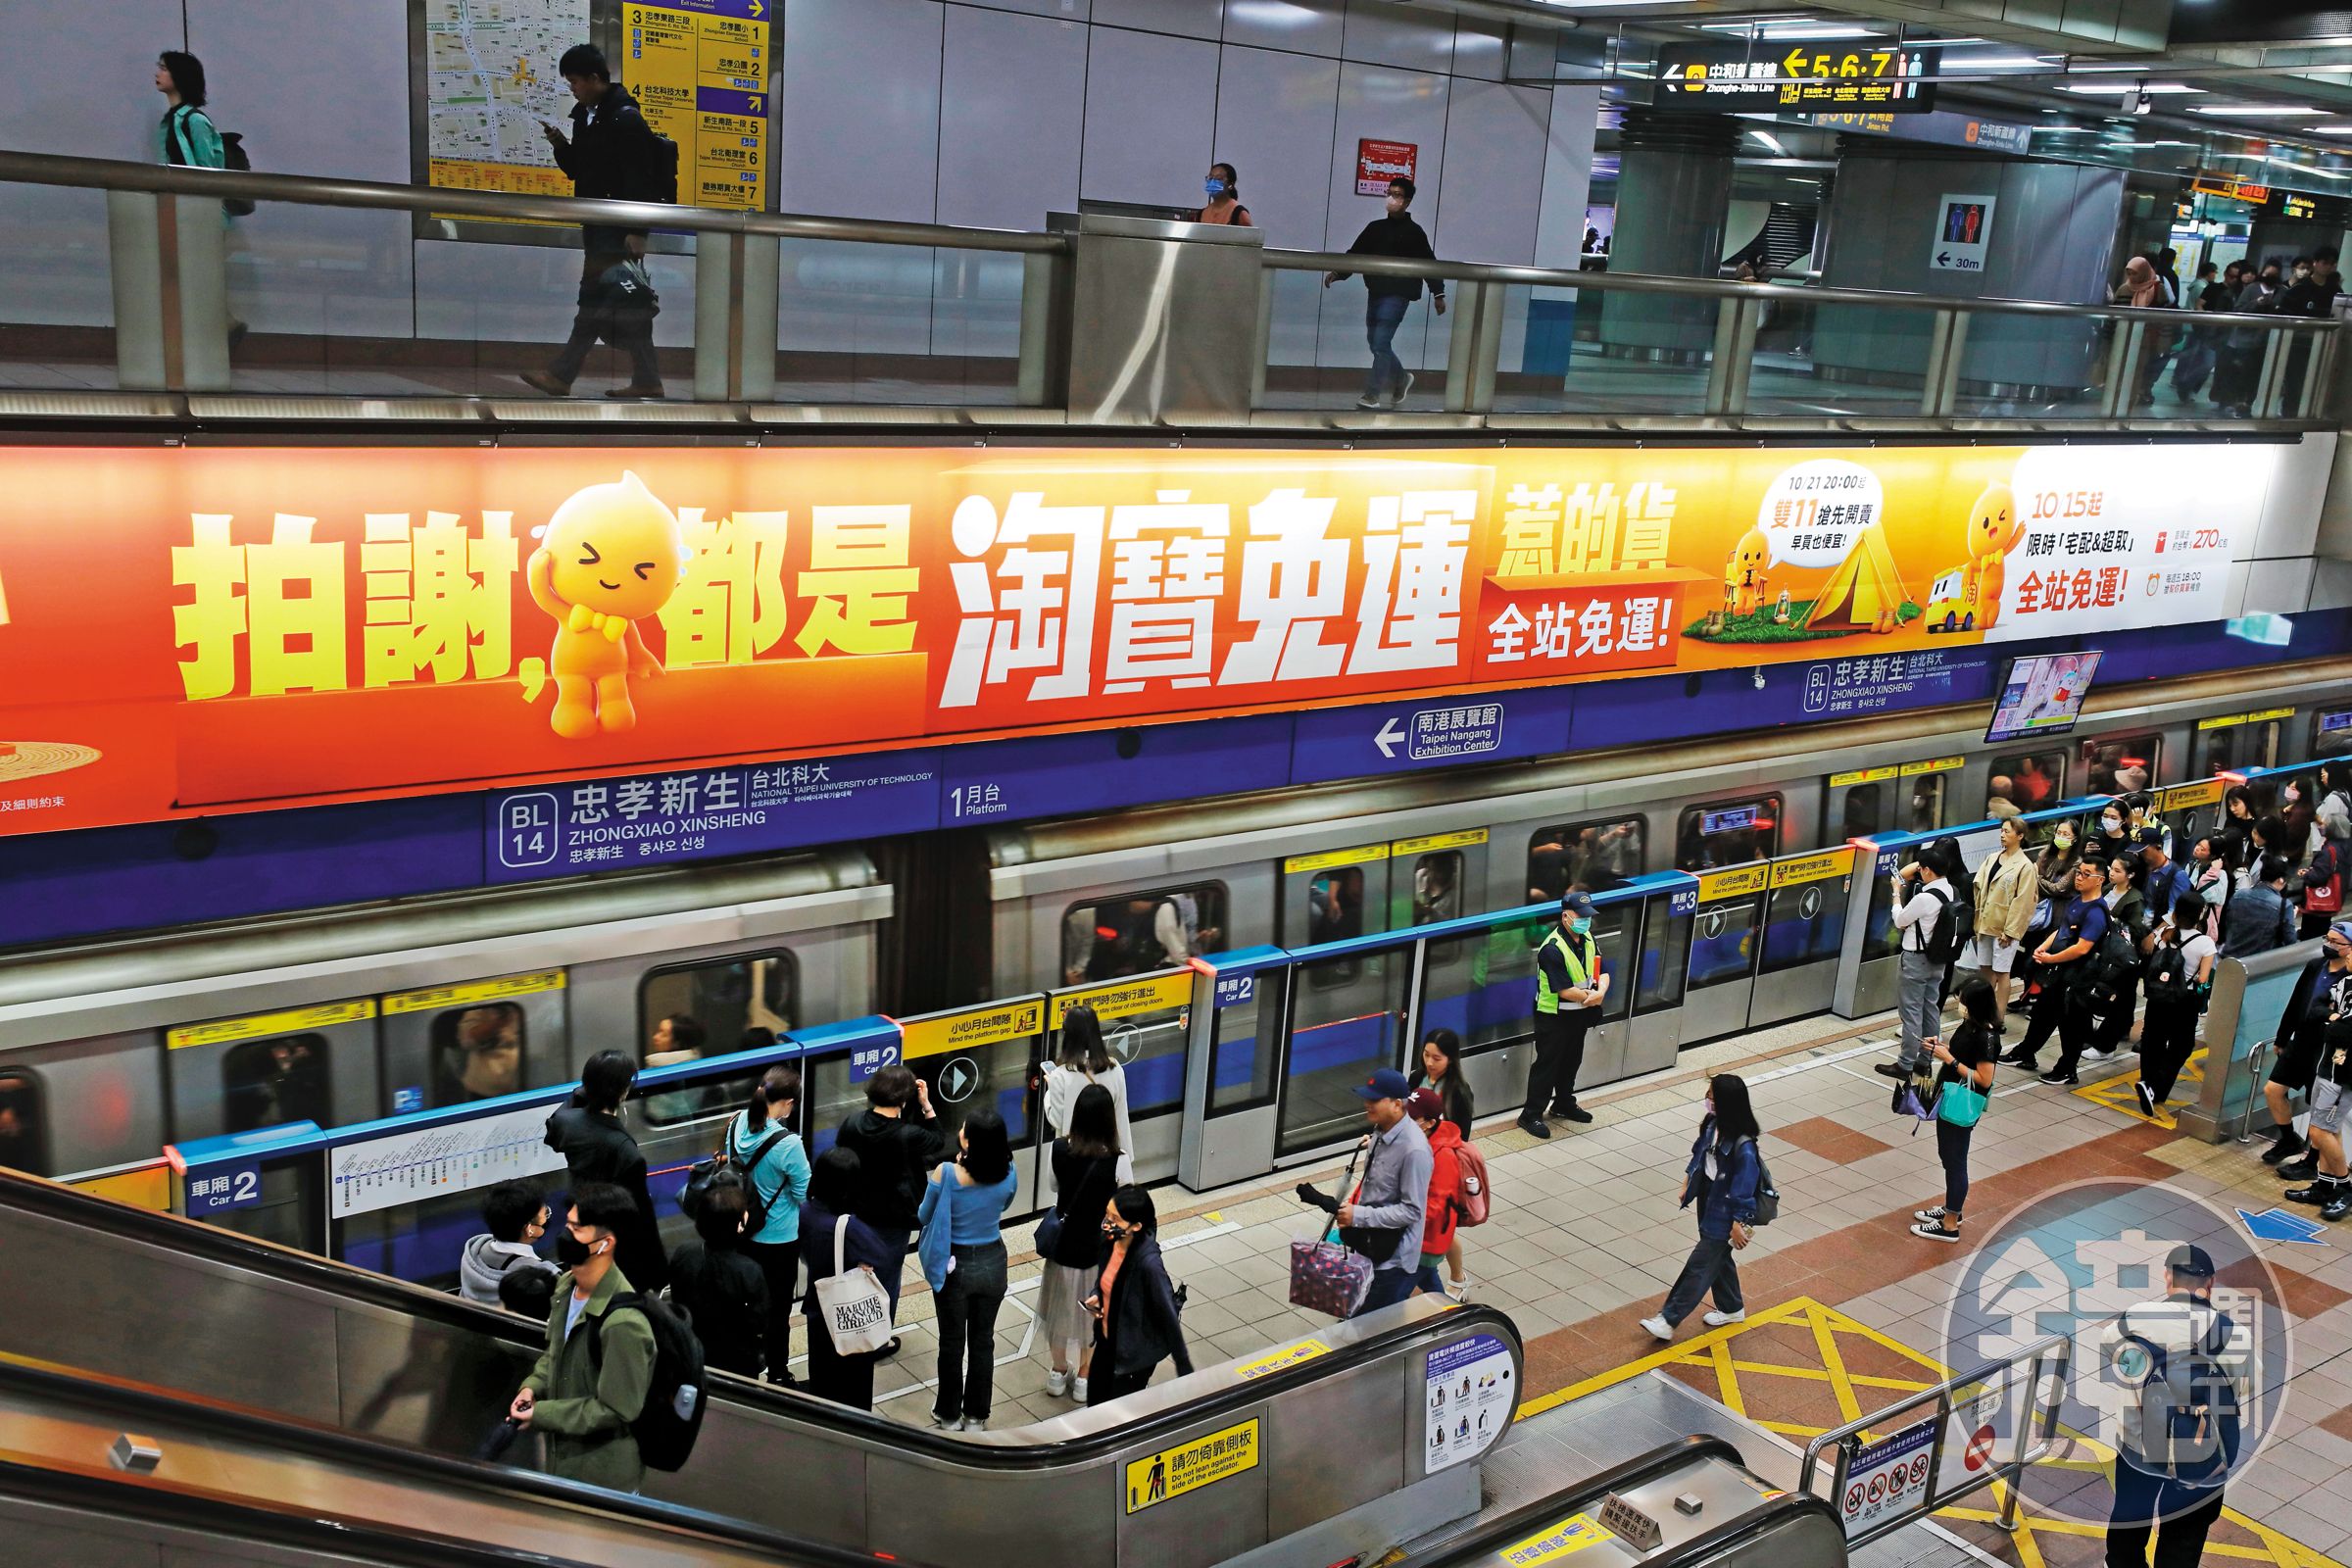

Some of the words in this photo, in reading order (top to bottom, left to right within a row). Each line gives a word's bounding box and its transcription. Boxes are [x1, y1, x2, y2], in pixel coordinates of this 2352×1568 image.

[633, 10, 642, 24] 3
[646, 12, 691, 25] 忠孝東路三段
[719, 22, 749, 32] 忠孝國小
[753, 27, 759, 39] 1
[718, 59, 748, 70] 忠孝公園
[751, 63, 760, 75] 2
[632, 84, 641, 97] 4
[645, 84, 689, 96] 台北科技大學
[704, 116, 747, 127] 新生南路一段
[750, 122, 758, 134] 5
[750, 152, 758, 165] 6
[749, 186, 757, 199] 7
[1956, 258, 1980, 270] 30m
[1771, 498, 1873, 529] 雙11搶先開賣
[657, 504, 920, 670] 都是
[938, 488, 1479, 709] 淘寶免運
[1496, 481, 1677, 576] 惹的貨
[1909, 652, 1943, 668] 台北科大
[1810, 671, 1826, 688] BL
[1834, 655, 1906, 686] 忠孝新生
[1809, 690, 1823, 705] 14
[1832, 686, 1875, 700] ZHONGXIAO
[1876, 681, 1913, 695] XINSHENG
[1417, 707, 1497, 733] 南港展覽館
[1421, 731, 1448, 746] Taipei
[1450, 729, 1492, 740] Nangang
[1415, 744, 1461, 758] Exhibition
[1463, 740, 1494, 752] Center
[751, 787, 792, 799] NATIONAL
[794, 784, 819, 795] TAIPEI
[820, 779, 866, 793] UNIVERSITY
[868, 777, 879, 786] OF
[880, 771, 933, 785] TECHNOLOGY
[752, 763, 830, 790] 台北科大
[569, 771, 740, 824] 忠孝新生
[951, 787, 962, 817] 1
[965, 783, 1001, 804] 月台
[0, 796, 66, 811] 及細則約束
[965, 802, 1007, 816] Platform
[512, 805, 549, 829] BL
[568, 820, 675, 846] ZHONGXIAO
[680, 810, 766, 834] XINSHENG
[513, 831, 545, 857] 14
[639, 839, 677, 856] 중샤오
[680, 836, 706, 851] 신성
[569, 845, 624, 863] 忠孝新生
[1671, 892, 1687, 905] 車廂
[1687, 891, 1696, 909] 3
[1217, 978, 1239, 995] 車廂
[1238, 977, 1252, 999] 2
[1130, 1001, 1149, 1009] closing
[952, 1013, 1012, 1035] 小心月台間隙
[974, 1030, 999, 1041] platform
[999, 1027, 1011, 1037] gap
[854, 1049, 880, 1067] 車廂
[882, 1046, 898, 1067] 2
[864, 1065, 879, 1075] Car
[191, 1175, 230, 1197] 車廂
[234, 1171, 258, 1201] 2
[209, 1196, 231, 1206] Car
[837, 1310, 883, 1331] GIRBAUD
[1171, 1428, 1252, 1473] 請勿倚靠側板
[1171, 1474, 1182, 1483] Do
[1183, 1469, 1195, 1479] not
[1196, 1464, 1210, 1474] lean
[1210, 1455, 1235, 1468] against
[1171, 1479, 1186, 1491] side
[1187, 1476, 1195, 1485] of
[1196, 1472, 1206, 1482] the
[1207, 1460, 1240, 1477] escalator.
[1609, 1497, 1651, 1531] 扶梯速度快
[1604, 1507, 1647, 1540] 請緊握扶手
